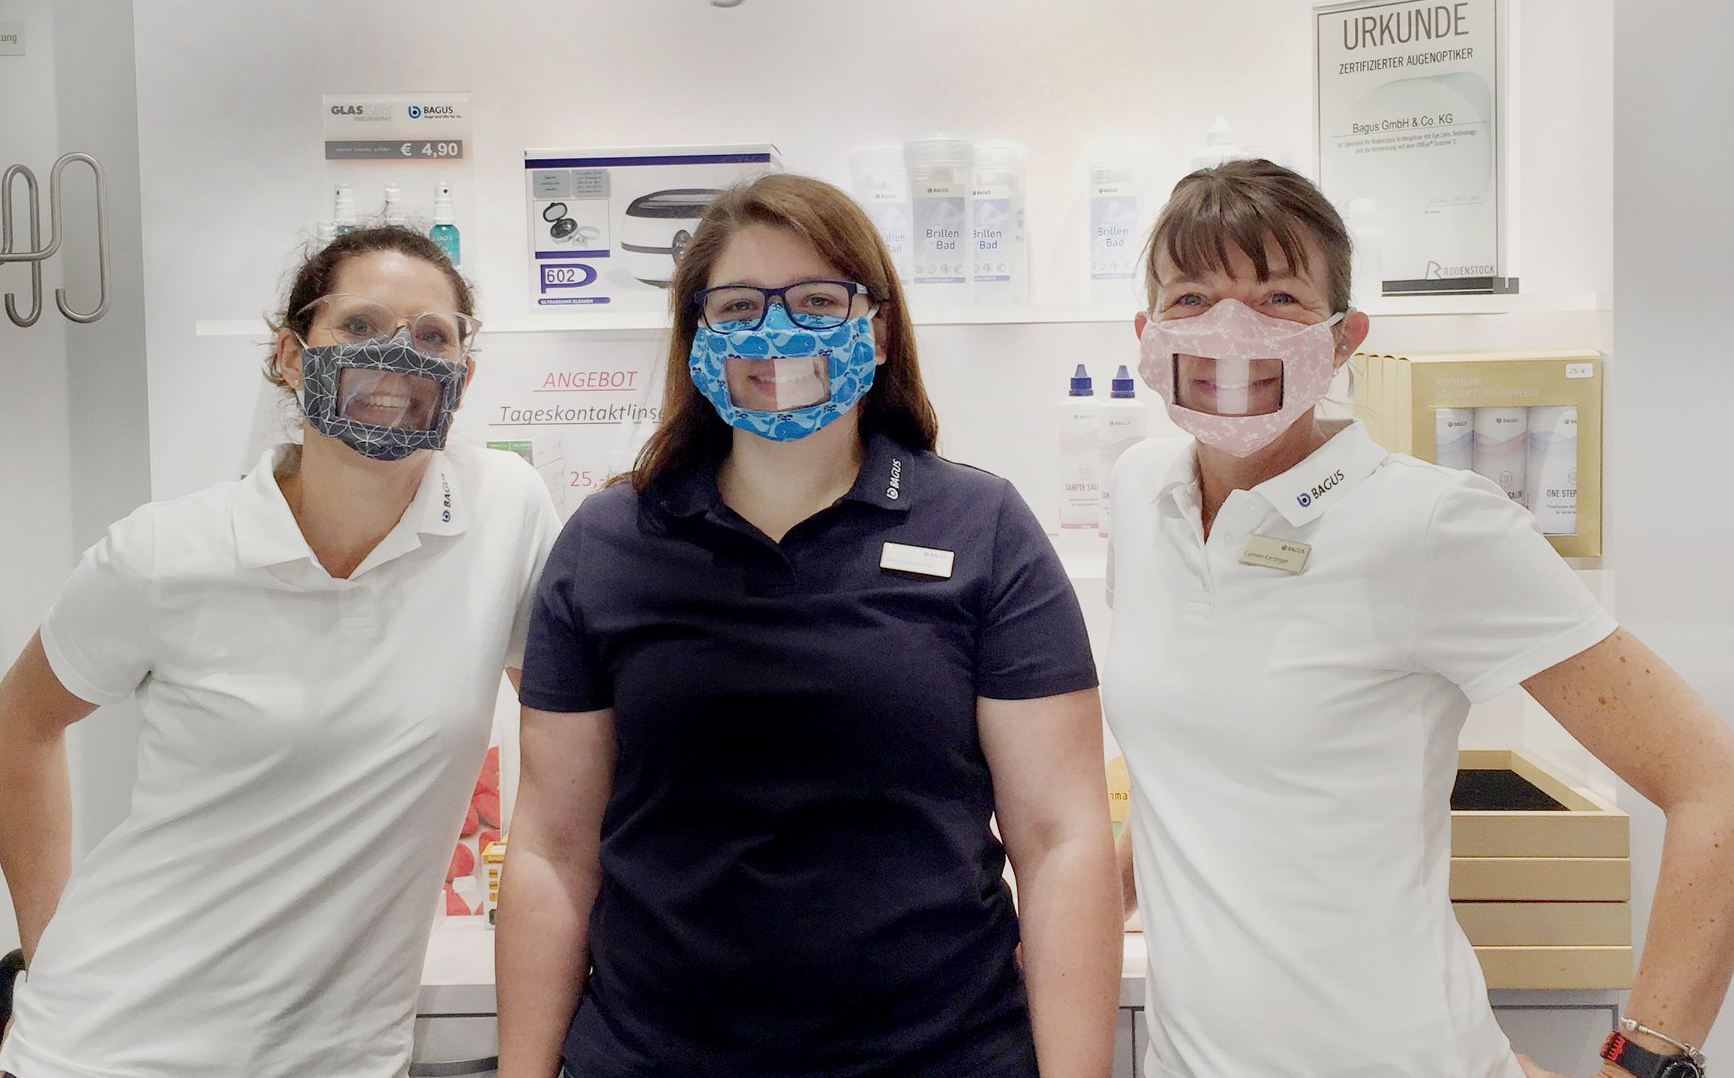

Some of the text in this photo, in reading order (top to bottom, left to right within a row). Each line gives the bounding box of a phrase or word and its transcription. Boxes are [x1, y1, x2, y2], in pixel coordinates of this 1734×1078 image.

[1343, 2, 1469, 51] URKUNDE
[0, 34, 17, 44] ung
[1339, 47, 1473, 75] ZERTIFIZIERTER AUGENOPTIKER
[423, 106, 454, 114] BAGUS
[1352, 113, 1453, 135] Bagus GmbH & Co. KG
[400, 143, 412, 156] €
[421, 143, 458, 157] 4,90
[926, 228, 959, 238] Brillen
[936, 240, 955, 250] Bad
[979, 240, 997, 250] Bad
[1106, 238, 1124, 247] Bad
[547, 269, 575, 282] 602
[1443, 265, 1495, 276] RODENSTOCK
[542, 371, 638, 388] ANGEBOT
[440, 472, 452, 508] BAGUS
[1065, 483, 1086, 491] SANFTE
[1311, 469, 1345, 500] BAGUS
[1546, 489, 1577, 498] ONE STEP
